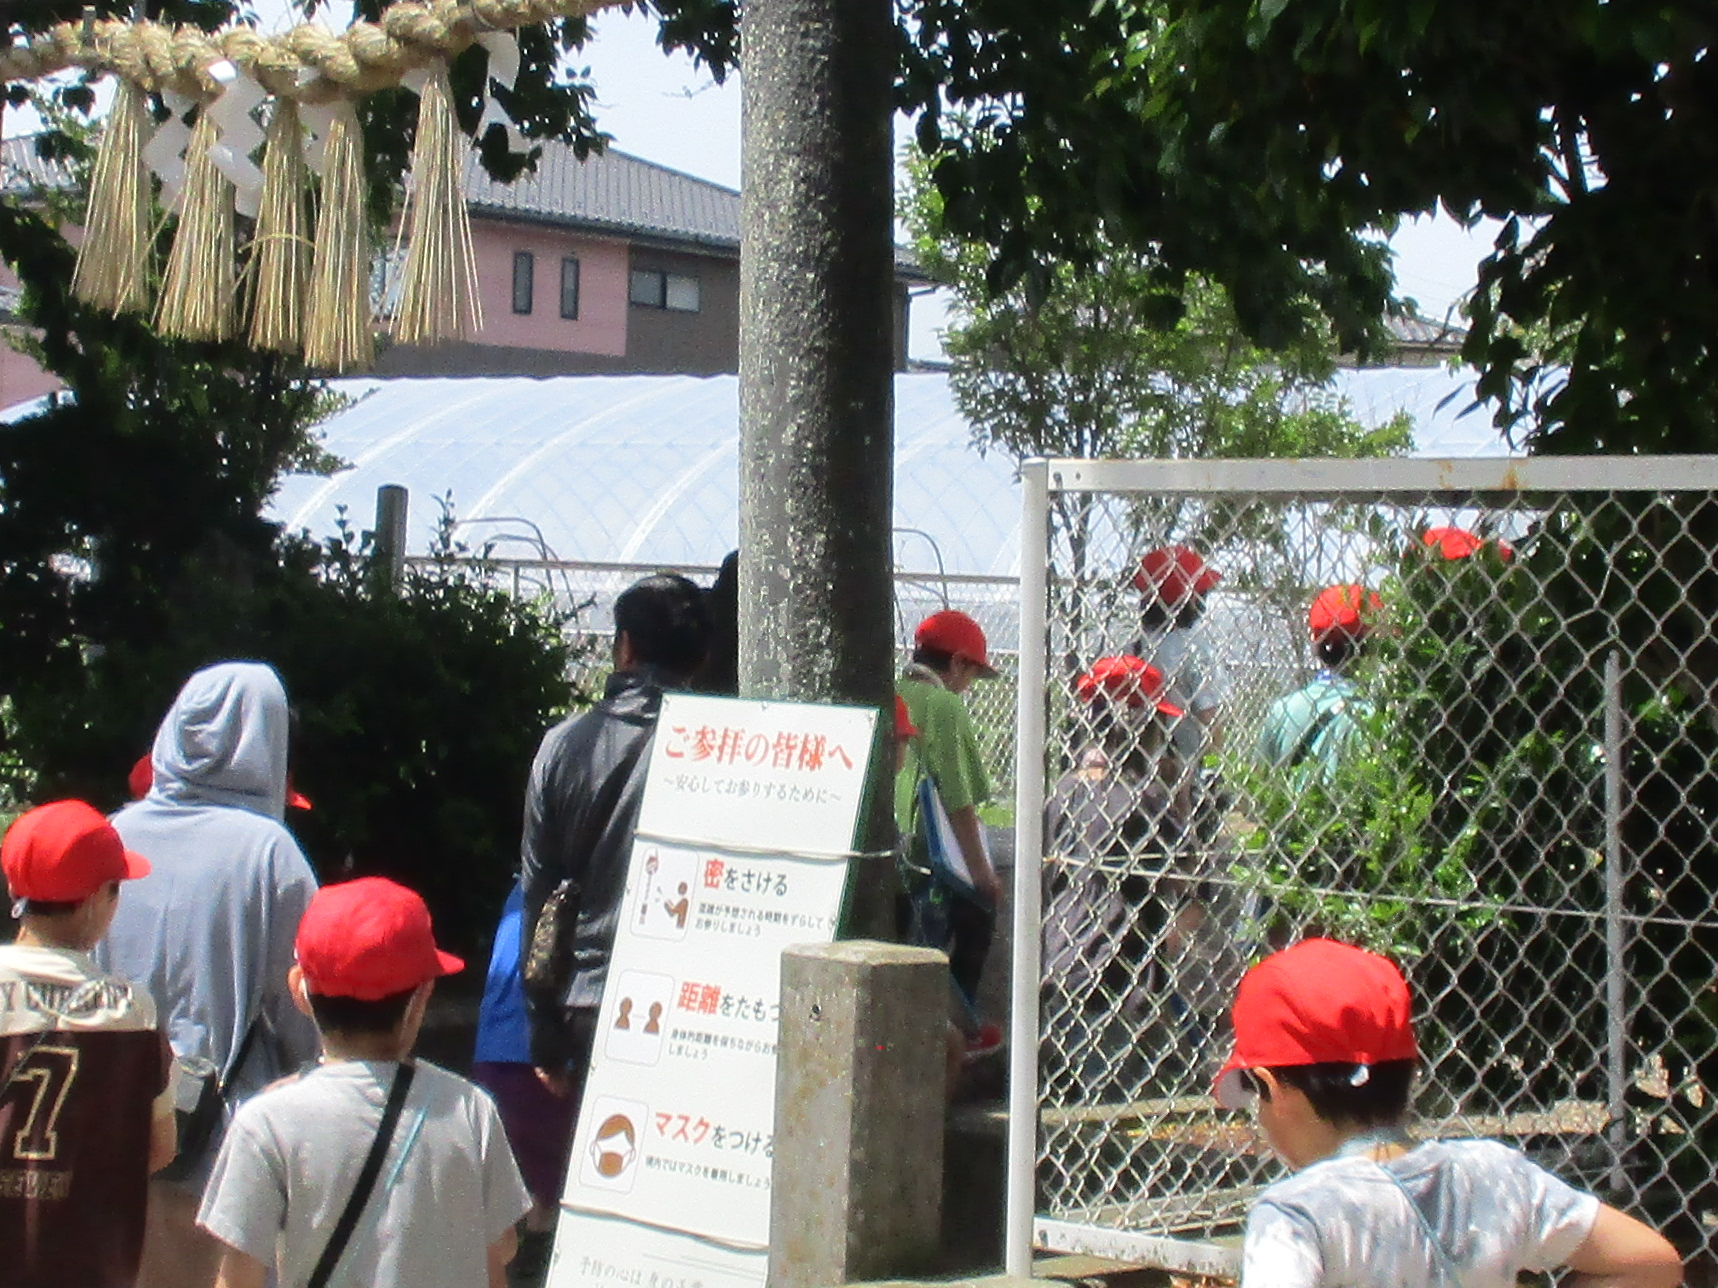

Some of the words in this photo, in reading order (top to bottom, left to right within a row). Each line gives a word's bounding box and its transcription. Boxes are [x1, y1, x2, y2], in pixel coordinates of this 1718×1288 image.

[666, 725, 853, 771] ご参拝の皆様へ
[704, 859, 788, 896] 密をさける
[677, 982, 780, 1022] 距離をたもつ
[668, 1042, 708, 1060] しましょう
[11, 1046, 79, 1160] 7
[655, 1112, 774, 1158] マスクをつける
